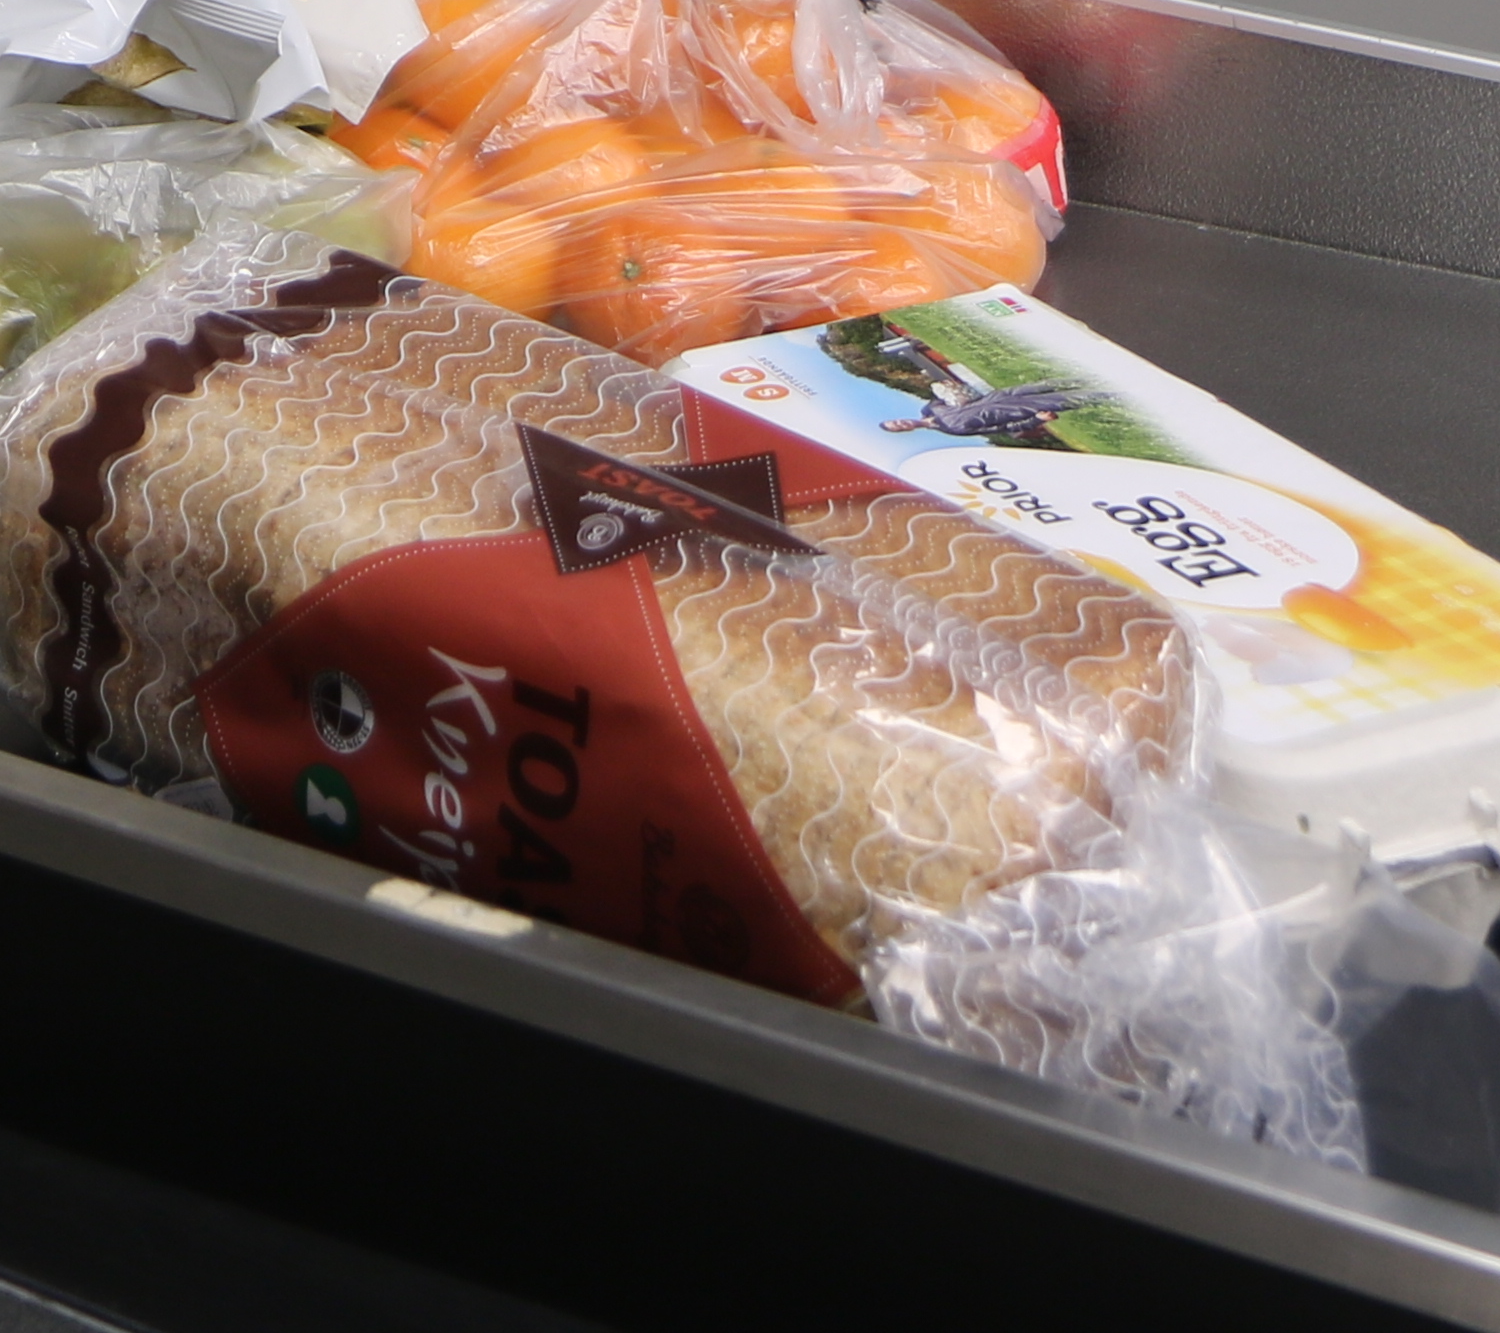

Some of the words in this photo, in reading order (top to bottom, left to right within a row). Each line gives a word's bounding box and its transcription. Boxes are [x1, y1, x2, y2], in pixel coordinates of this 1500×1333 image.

[575, 462, 719, 521] TOAST
[960, 460, 1072, 524] PRIOR
[1091, 496, 1261, 588] Egg
[72, 580, 95, 672] Sandwich
[378, 645, 507, 897] Kneip
[497, 678, 592, 921] TOA
